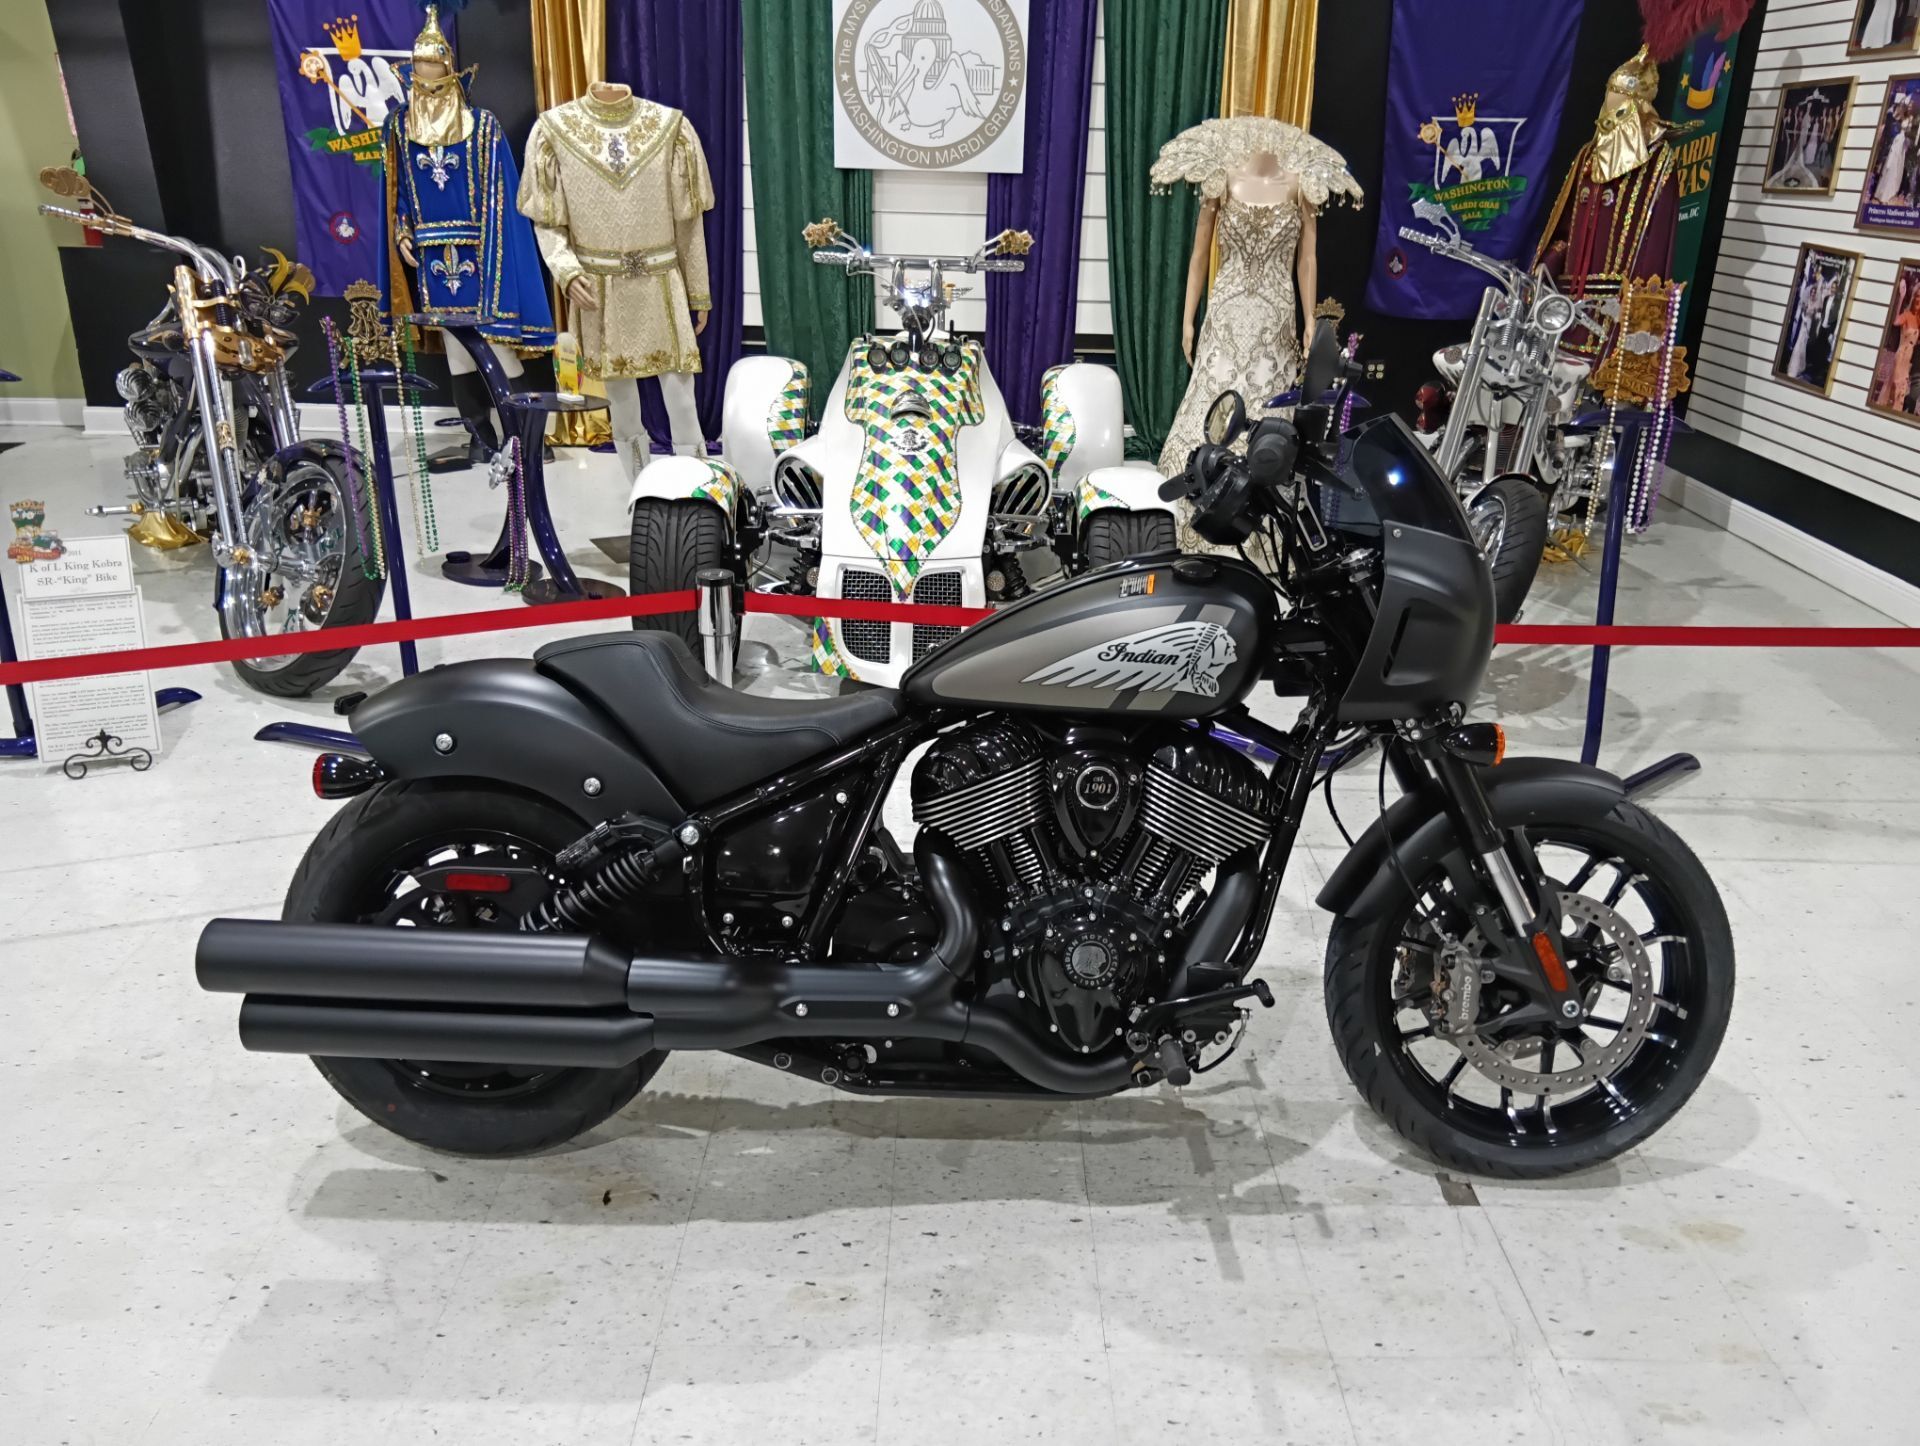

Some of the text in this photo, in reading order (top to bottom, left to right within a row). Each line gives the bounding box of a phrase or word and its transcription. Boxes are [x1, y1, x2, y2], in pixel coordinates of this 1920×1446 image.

[839, 0, 873, 66] The MYS
[843, 88, 1016, 165] WASHINGTON MARDI GRAS
[1434, 179, 1510, 202] WASHINGTON
[30, 559, 123, 573] K of L King Kobra
[95, 572, 118, 583] Bike
[1097, 642, 1180, 665] Indian
[1084, 783, 1112, 794] 1901
[1065, 934, 1119, 978] INDIAN MOTORCYCLE
[1459, 975, 1472, 1020] brembo
